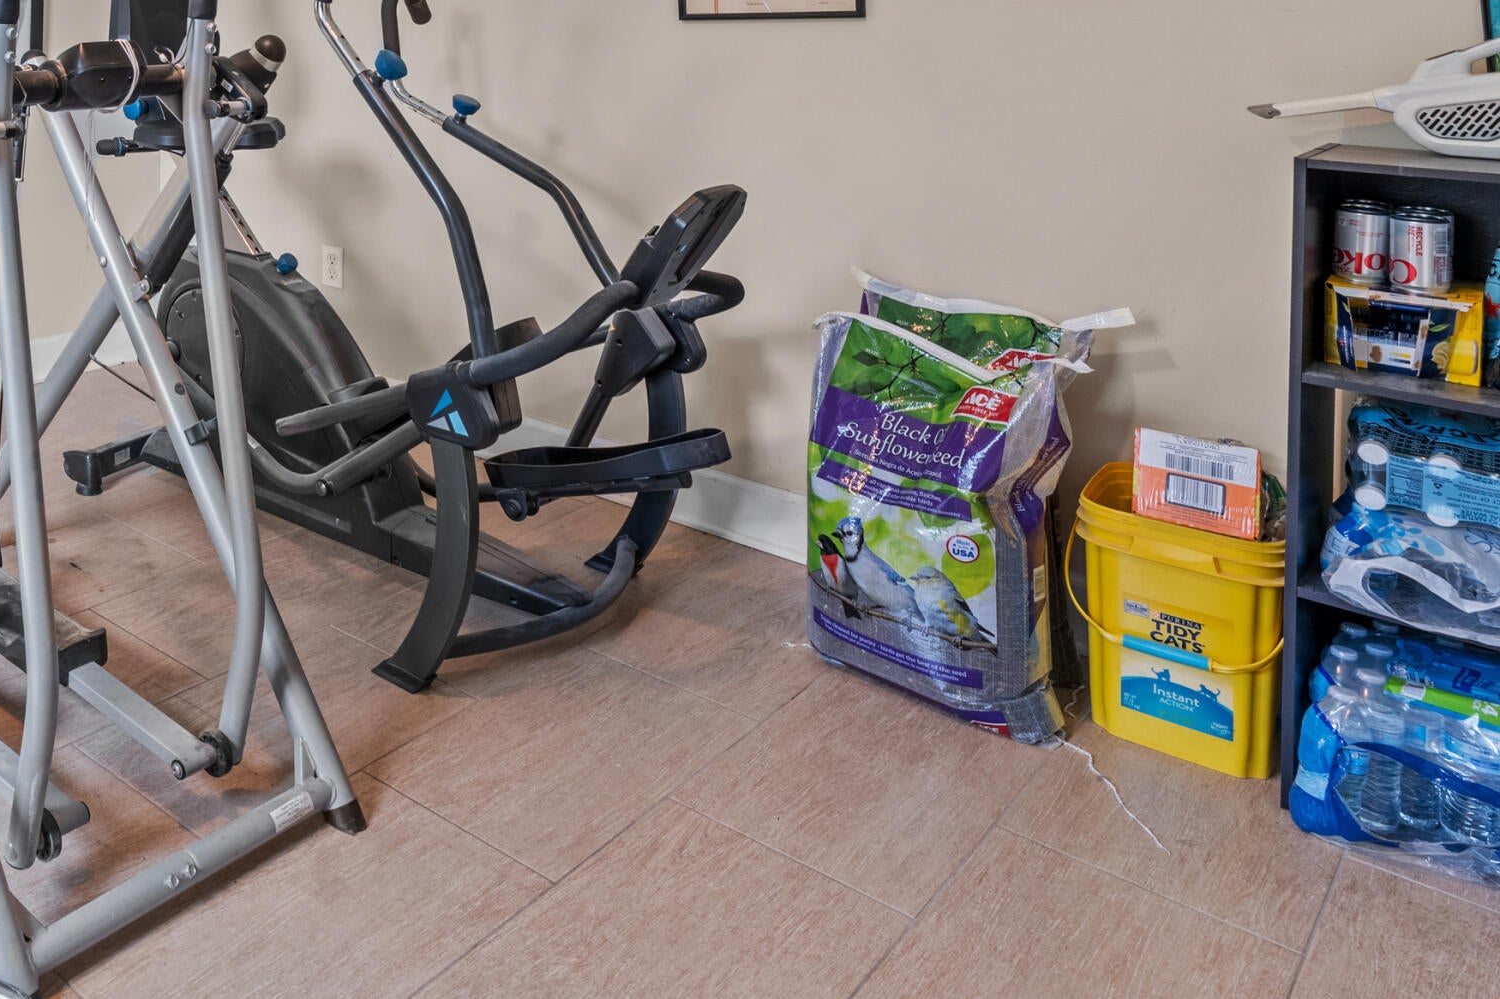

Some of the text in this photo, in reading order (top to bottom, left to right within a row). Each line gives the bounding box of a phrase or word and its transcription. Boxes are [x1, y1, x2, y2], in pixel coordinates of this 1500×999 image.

[1415, 225, 1424, 257] RECYCLE
[964, 391, 1002, 412] ACE
[880, 413, 931, 445] Black
[879, 458, 897, 471] Negra
[897, 464, 906, 473] de
[932, 448, 966, 469] eed
[952, 547, 975, 558] USA
[1151, 618, 1202, 642] TIDY
[1161, 613, 1201, 629] PURINA
[1150, 630, 1204, 654] CATS
[1152, 683, 1200, 708] Instant
[1159, 696, 1194, 713] ACTION
